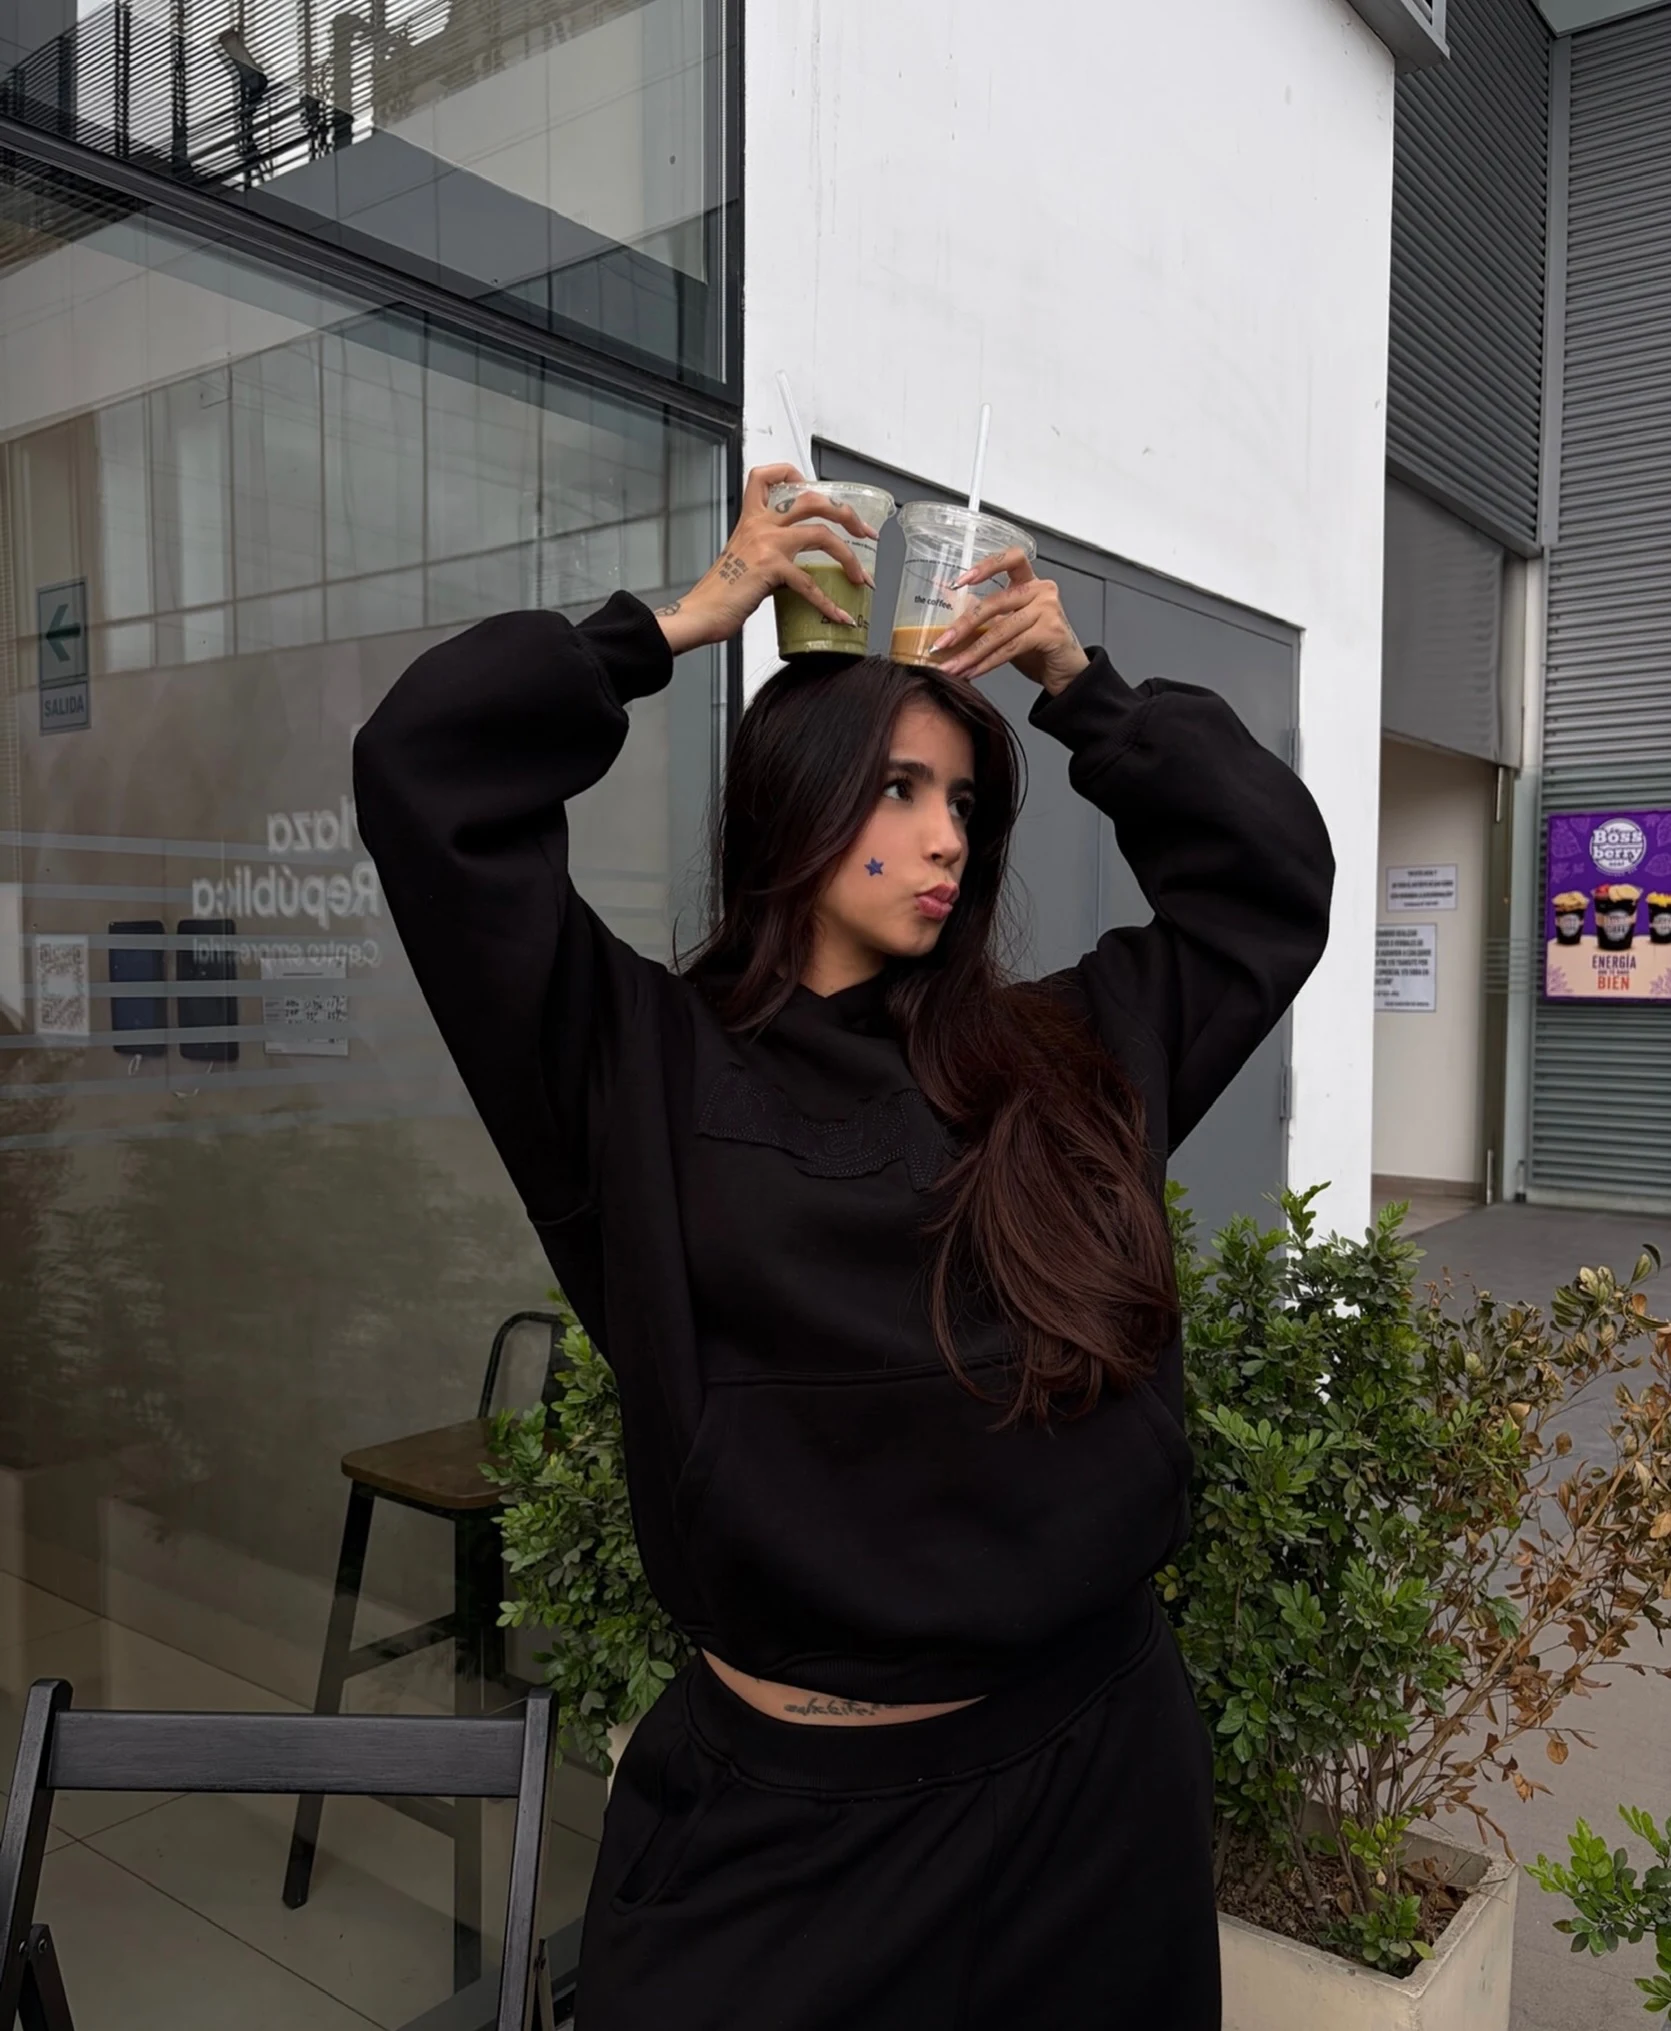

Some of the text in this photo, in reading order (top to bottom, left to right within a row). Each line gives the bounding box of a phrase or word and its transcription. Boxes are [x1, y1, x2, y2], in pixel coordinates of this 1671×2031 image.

[914, 595, 926, 604] the
[44, 695, 85, 717] SALIDA
[1592, 953, 1636, 969] ENERGÍA
[1598, 976, 1629, 990] BIEN
